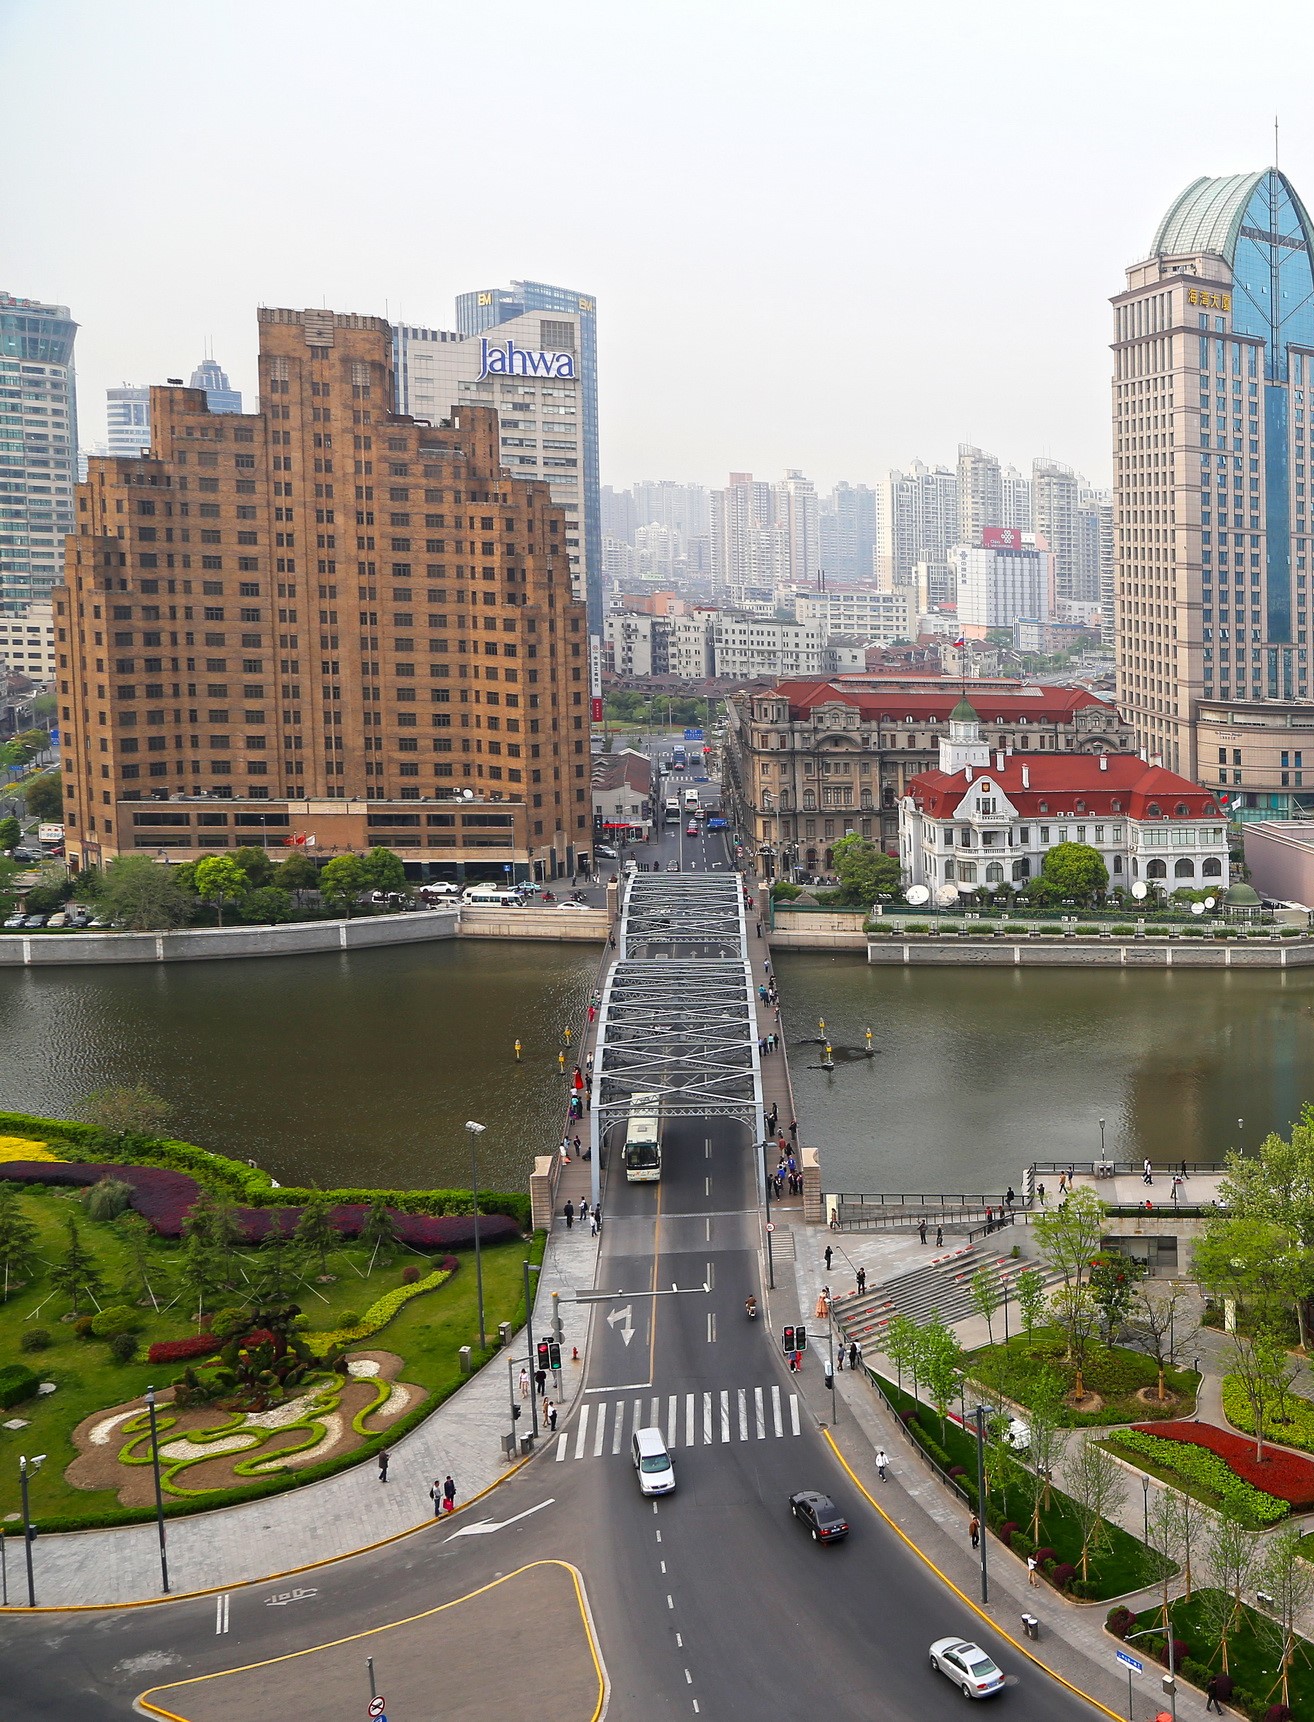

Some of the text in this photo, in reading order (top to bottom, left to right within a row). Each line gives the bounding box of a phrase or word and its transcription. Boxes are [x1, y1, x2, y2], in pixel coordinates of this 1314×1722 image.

[1187, 288, 1231, 312] 海湾大厦
[475, 336, 576, 382] Jahwa
